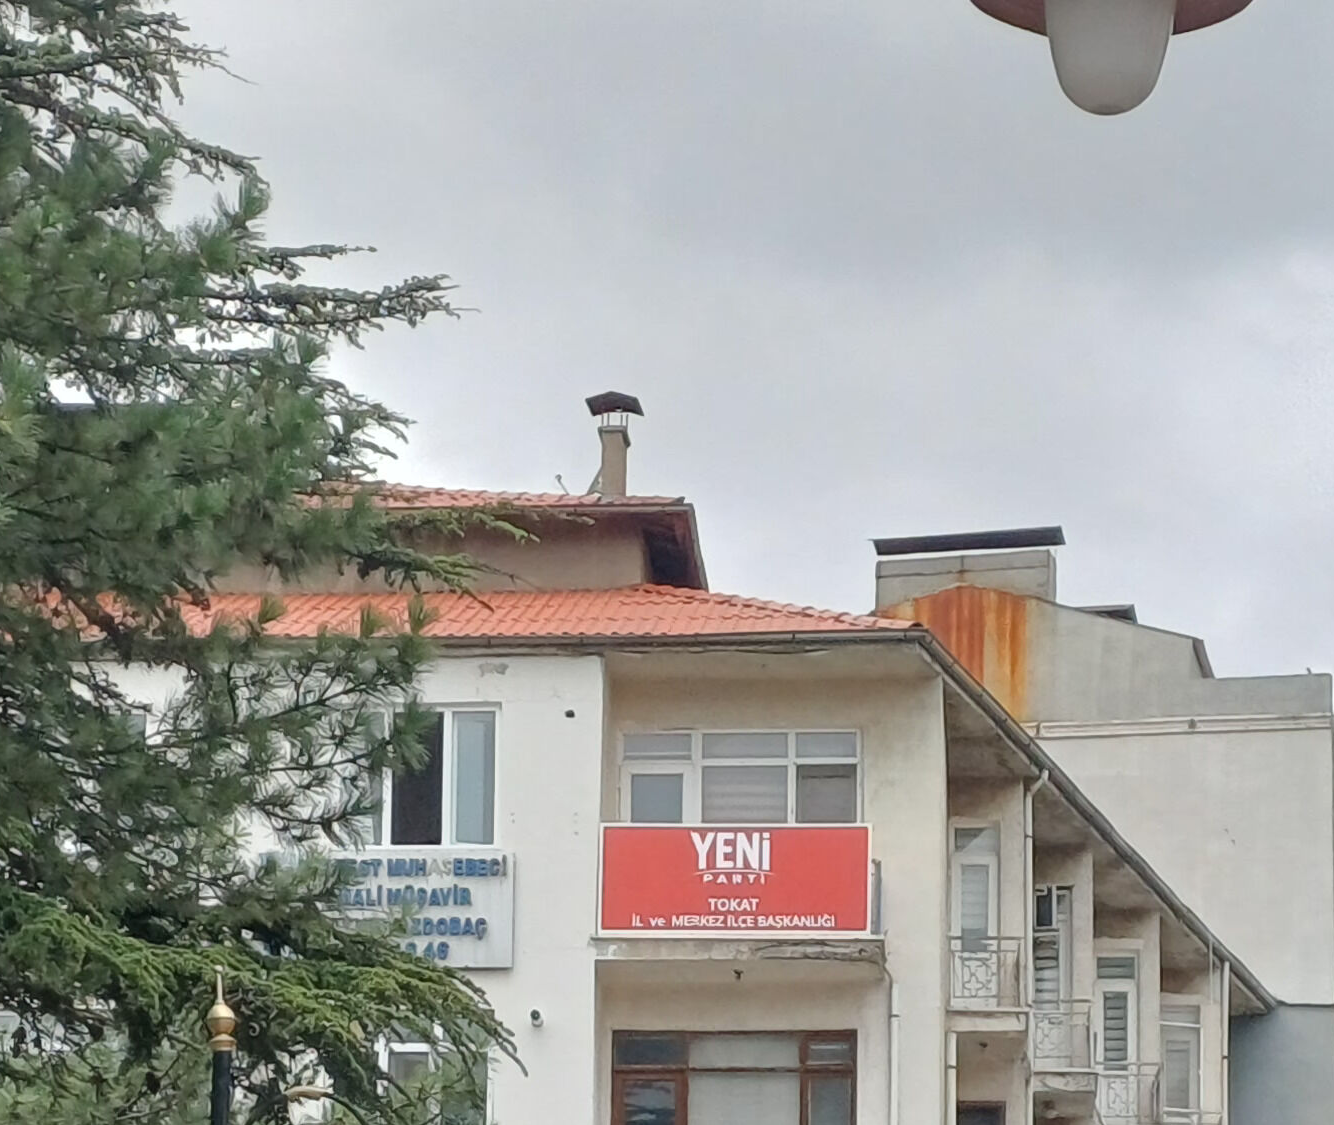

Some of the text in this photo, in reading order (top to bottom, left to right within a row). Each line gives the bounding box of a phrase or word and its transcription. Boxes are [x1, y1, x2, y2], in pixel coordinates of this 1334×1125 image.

[691, 830, 771, 871] YENİ
[708, 897, 759, 912] TOKAT
[650, 916, 666, 927] ve
[671, 915, 724, 927] MERKEZ
[757, 913, 835, 929] BAŞKANLIĞI
